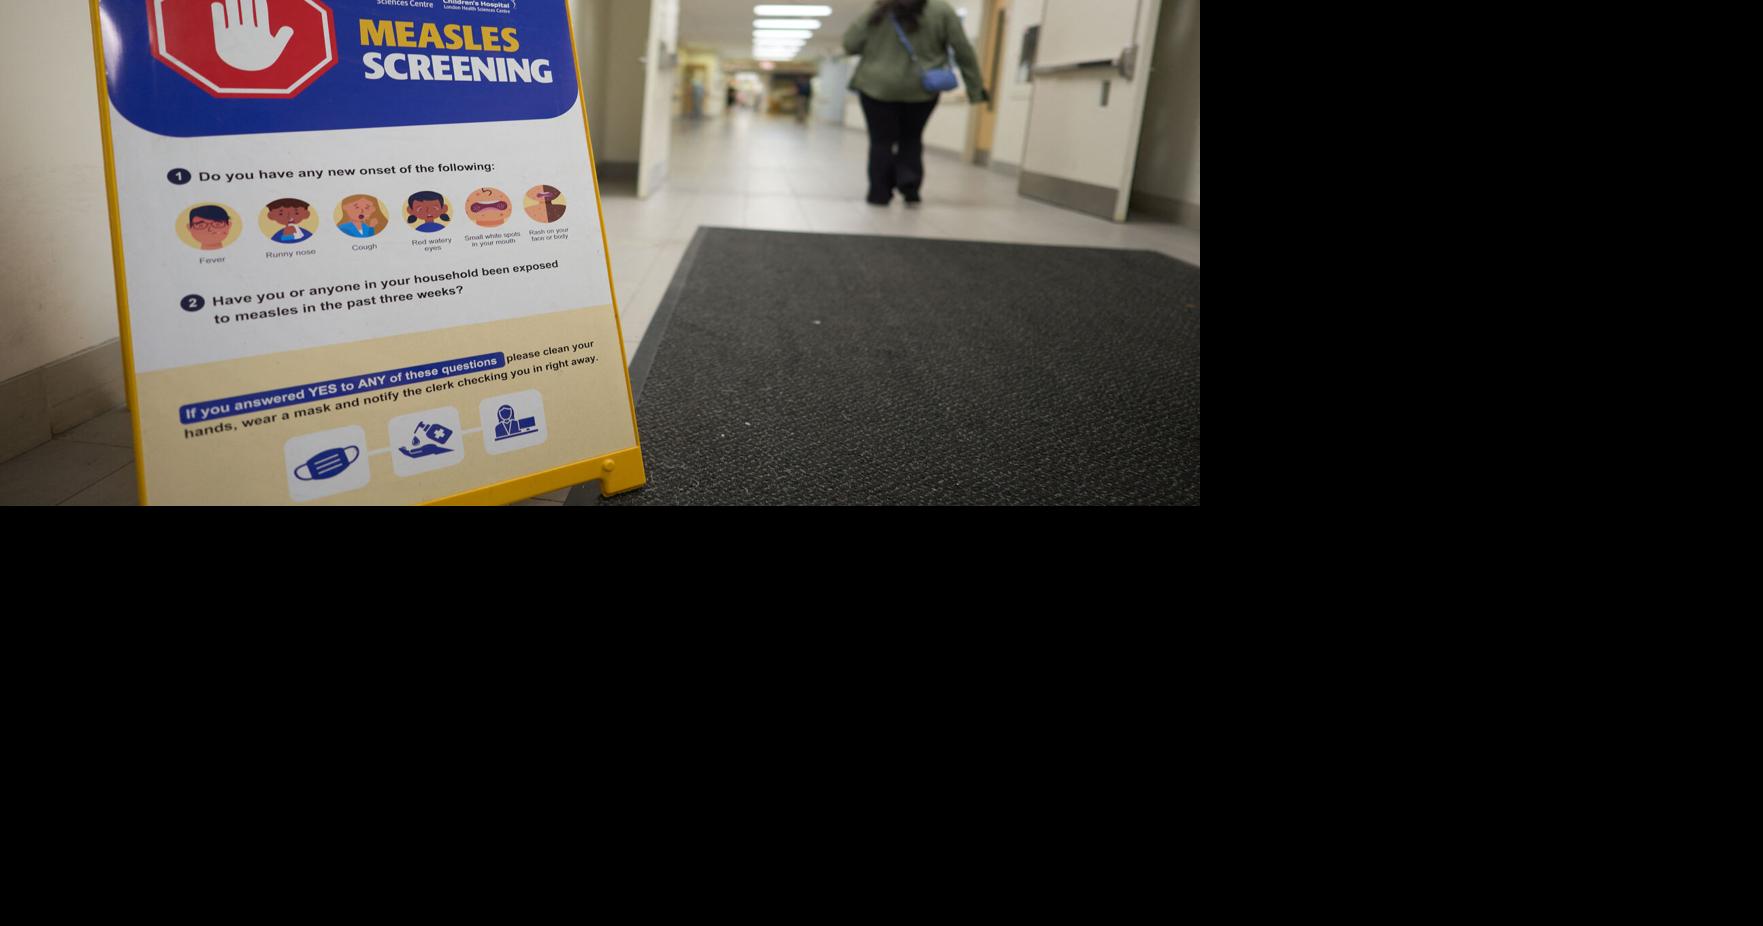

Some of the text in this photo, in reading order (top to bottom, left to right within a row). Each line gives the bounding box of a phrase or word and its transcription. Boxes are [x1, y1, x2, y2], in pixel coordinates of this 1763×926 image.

[410, 0, 433, 8] Centre
[480, 1, 510, 9] Hospital
[359, 19, 520, 53] MEASLES
[363, 52, 553, 84] SCREENING
[175, 162, 495, 183] 1 Do you have any new onset of the following:
[200, 256, 226, 264] Fever
[266, 250, 293, 258] Runny
[352, 243, 378, 251] Cough
[188, 260, 558, 308] 2 Have you or anyone in your household been exposed
[214, 285, 464, 324] to measles in the past three weeks?
[186, 340, 594, 420] If you answered YES to ANY of these questions please clean your
[184, 355, 598, 439] hands, wear a mask and notify the clerk checking you in right away.
